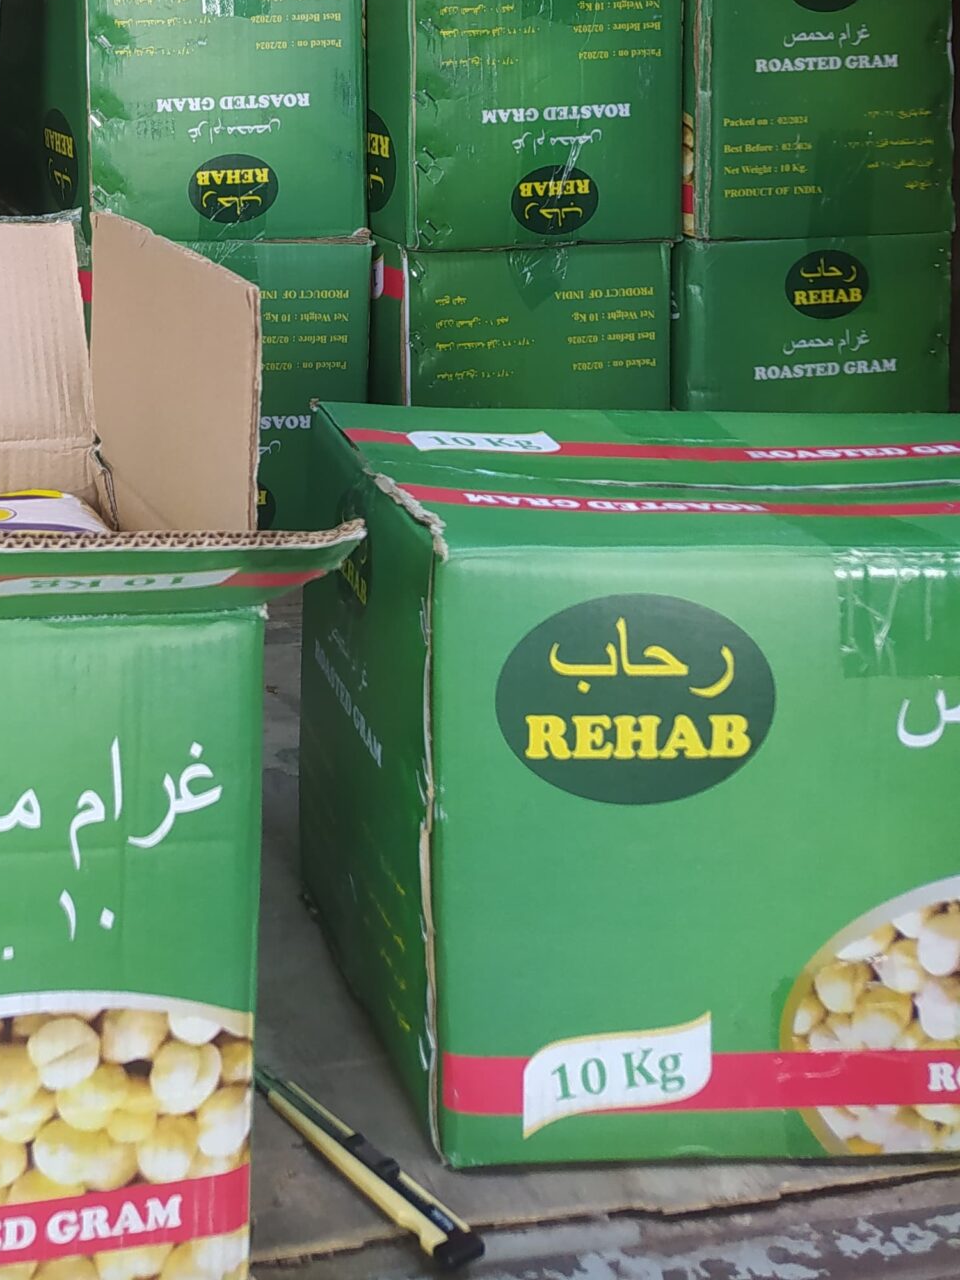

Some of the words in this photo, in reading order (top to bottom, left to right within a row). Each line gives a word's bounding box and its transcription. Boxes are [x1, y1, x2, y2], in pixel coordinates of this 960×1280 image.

[756, 57, 841, 72] ROASTED
[845, 55, 898, 68] GRAM
[157, 97, 214, 112] GRAM
[220, 93, 309, 109] ROASTED
[482, 108, 538, 123] GRAM
[544, 104, 630, 120] ROASTED
[196, 168, 268, 185] REHAB
[519, 179, 590, 197] REHAB
[524, 202, 582, 227] رحاب
[795, 288, 862, 305] REHAB
[755, 363, 839, 380] ROASTED
[844, 359, 896, 374] GRAM
[428, 435, 476, 447] 10
[483, 436, 543, 451] Kg
[743, 446, 908, 459] ROASTED
[463, 493, 581, 509] GRAM
[587, 500, 770, 512] ROASTED
[550, 618, 734, 697] رحاب
[526, 715, 750, 759] REHAB
[69, 736, 222, 870] غرام
[551, 1057, 607, 1101] 10
[622, 1048, 686, 1093] Kg
[47, 1195, 182, 1244] GRAM
